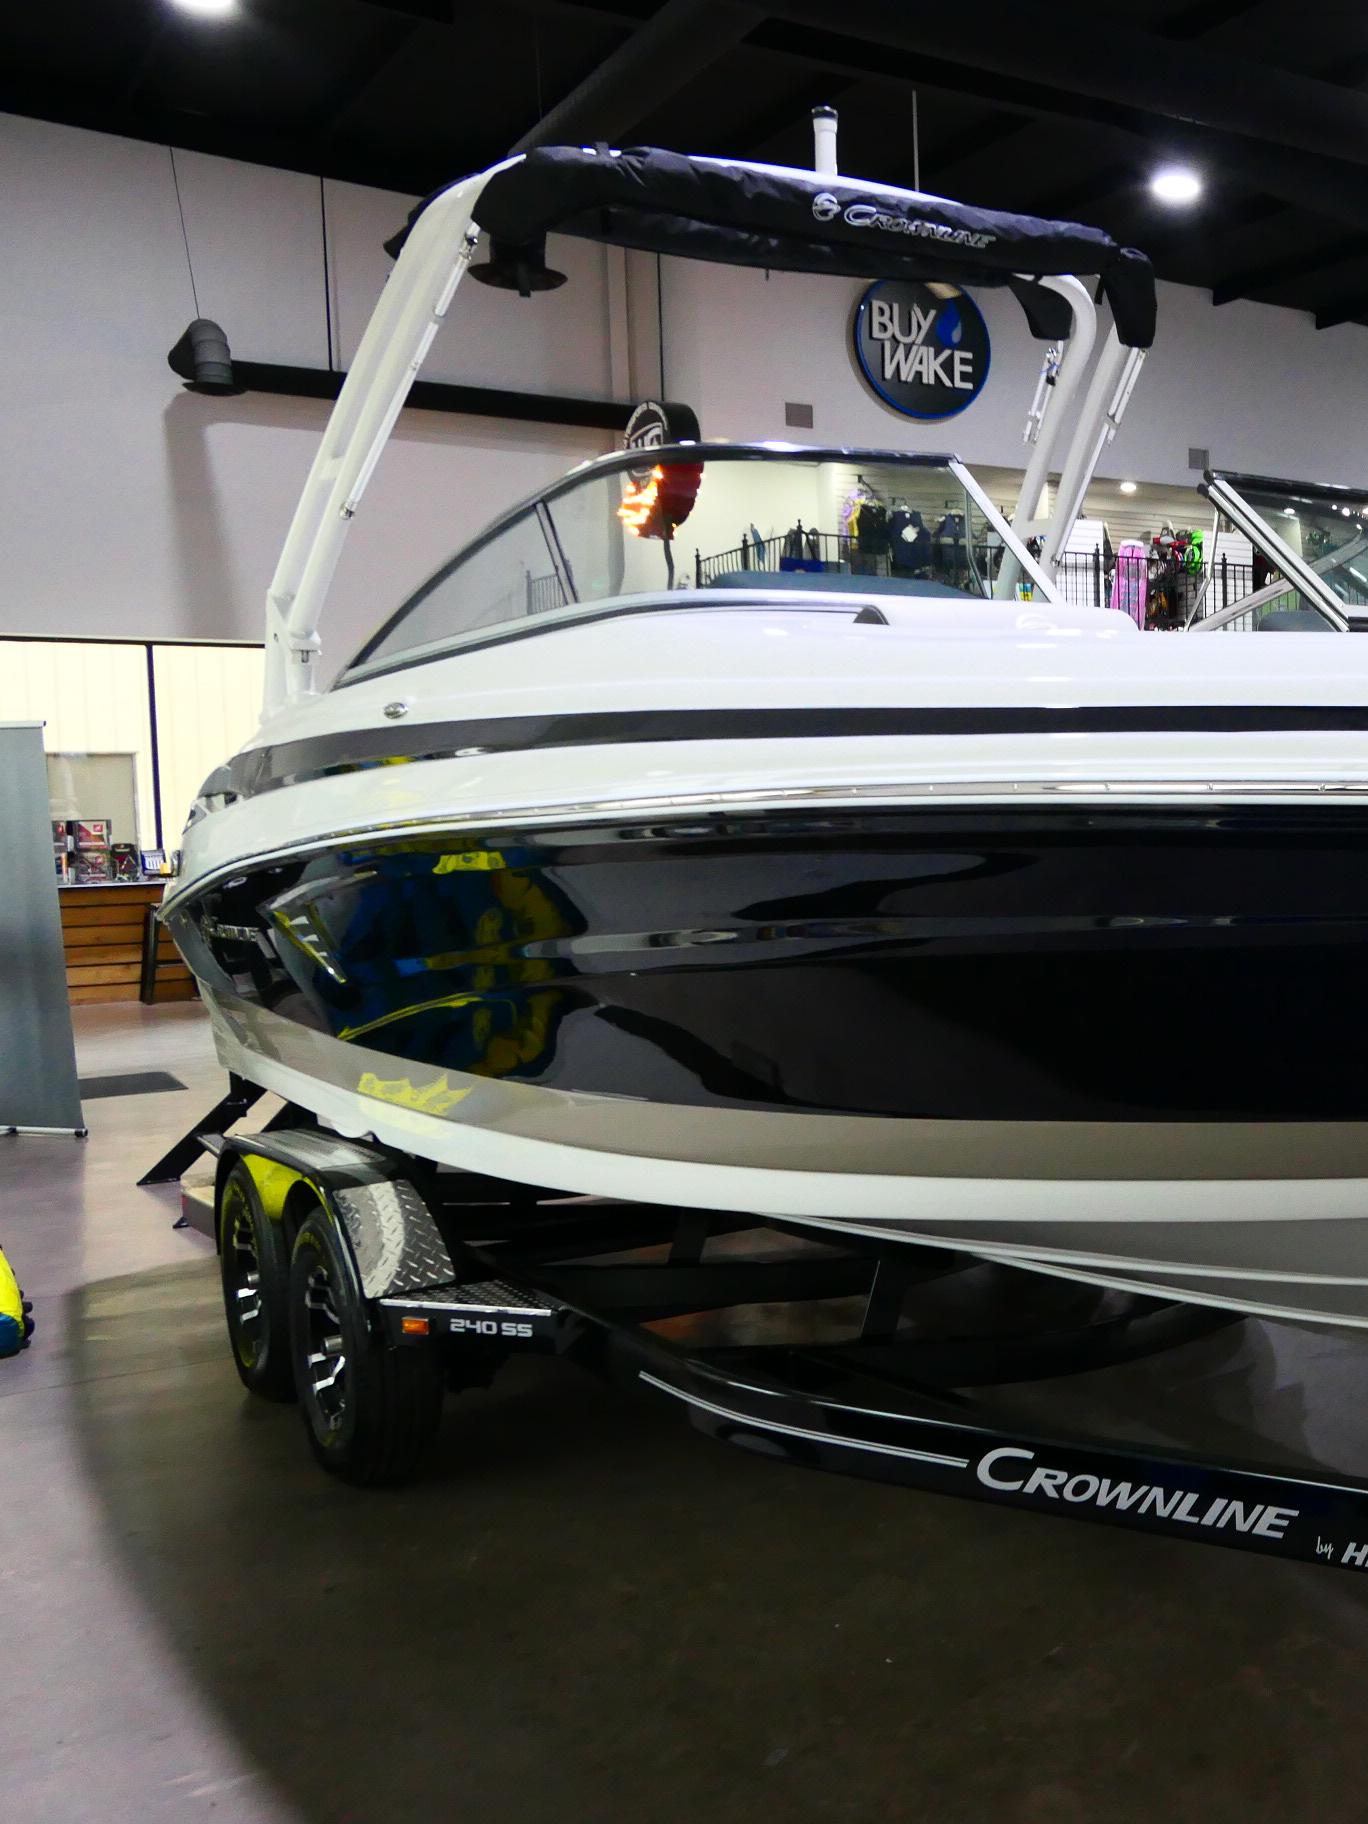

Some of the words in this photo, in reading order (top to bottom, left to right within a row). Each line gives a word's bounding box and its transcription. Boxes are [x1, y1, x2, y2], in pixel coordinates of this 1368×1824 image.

[870, 299, 936, 344] BUY
[883, 340, 974, 390] WAKE
[450, 1318, 498, 1335] 240
[501, 1322, 533, 1338] SS
[976, 1447, 1300, 1539] CROWNLINE
[1315, 1536, 1334, 1560] by
